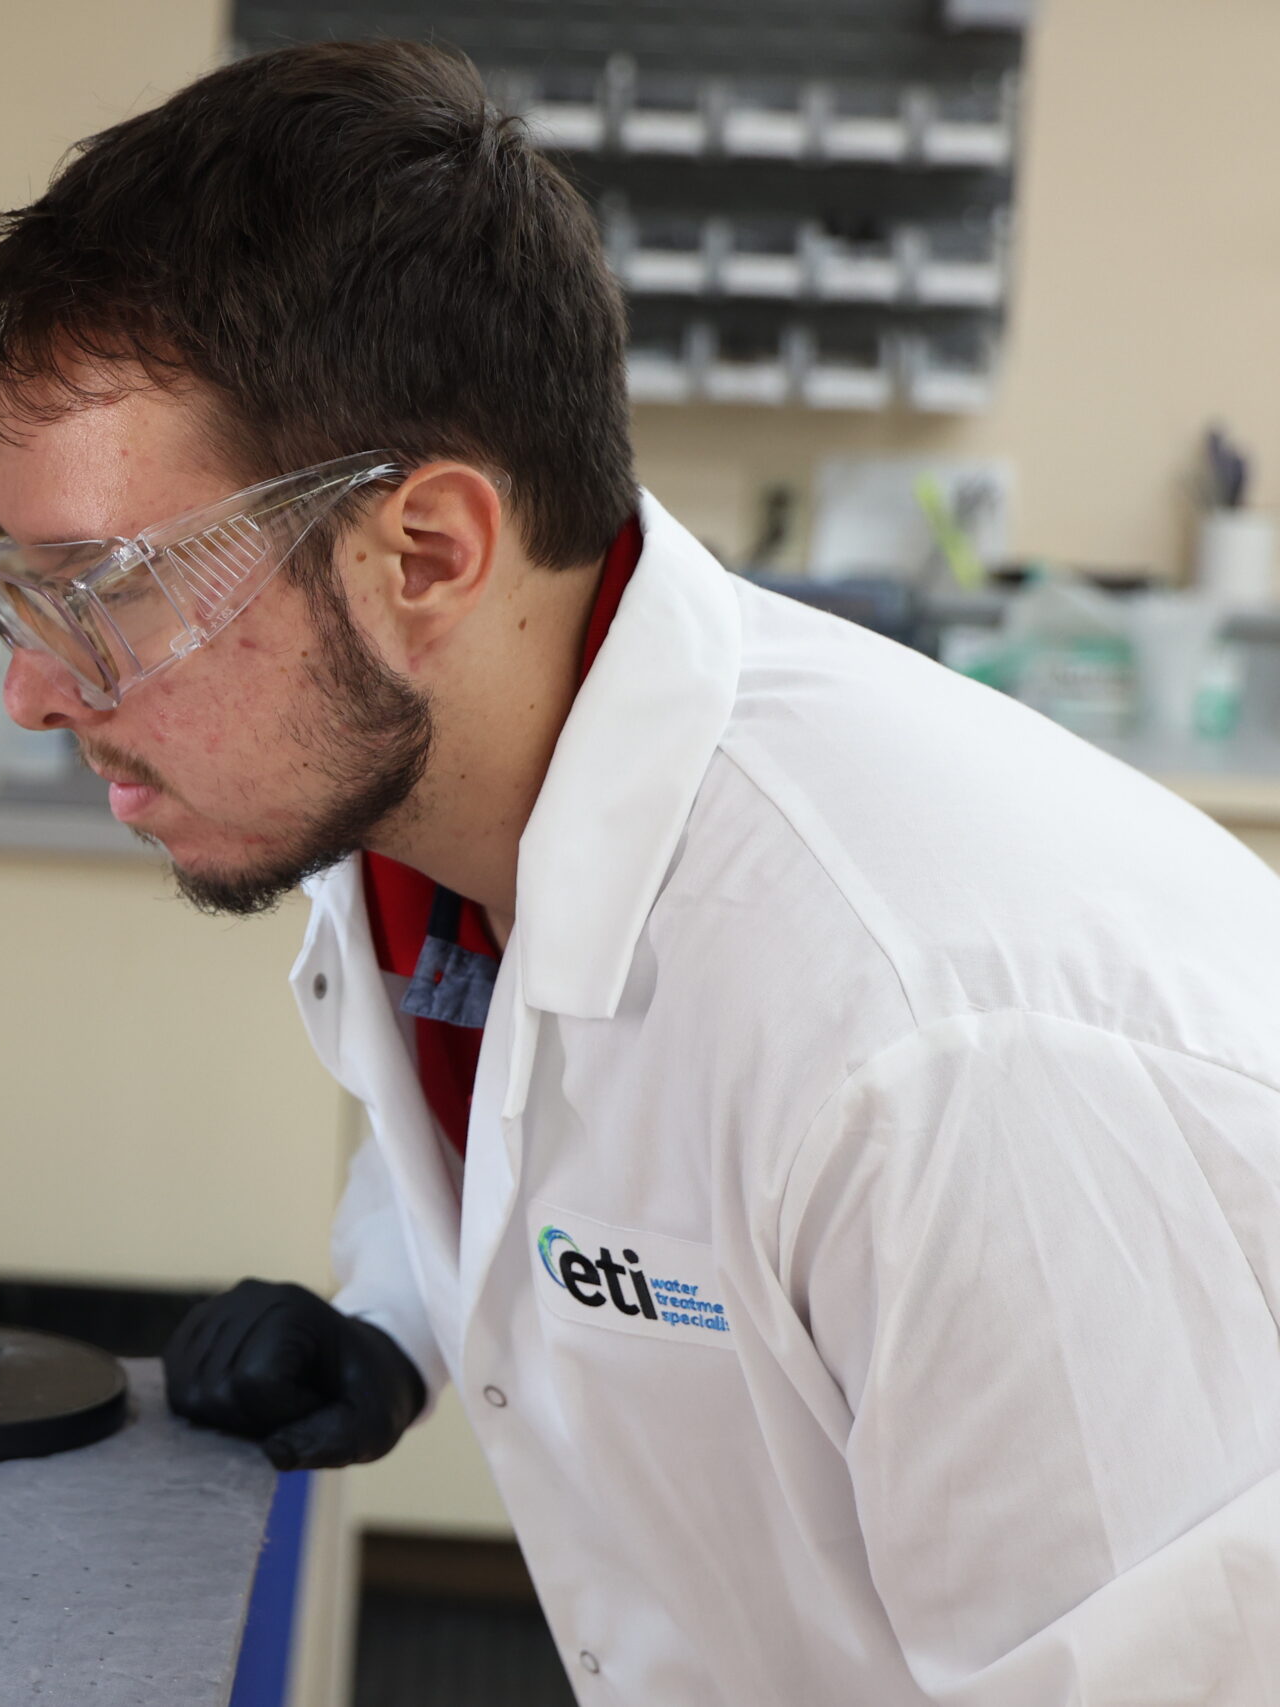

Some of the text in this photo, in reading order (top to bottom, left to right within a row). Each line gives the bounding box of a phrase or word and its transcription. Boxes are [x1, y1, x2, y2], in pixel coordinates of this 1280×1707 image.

[559, 1247, 658, 1320] eti
[650, 1277, 699, 1297] water
[655, 1291, 724, 1315] treatme
